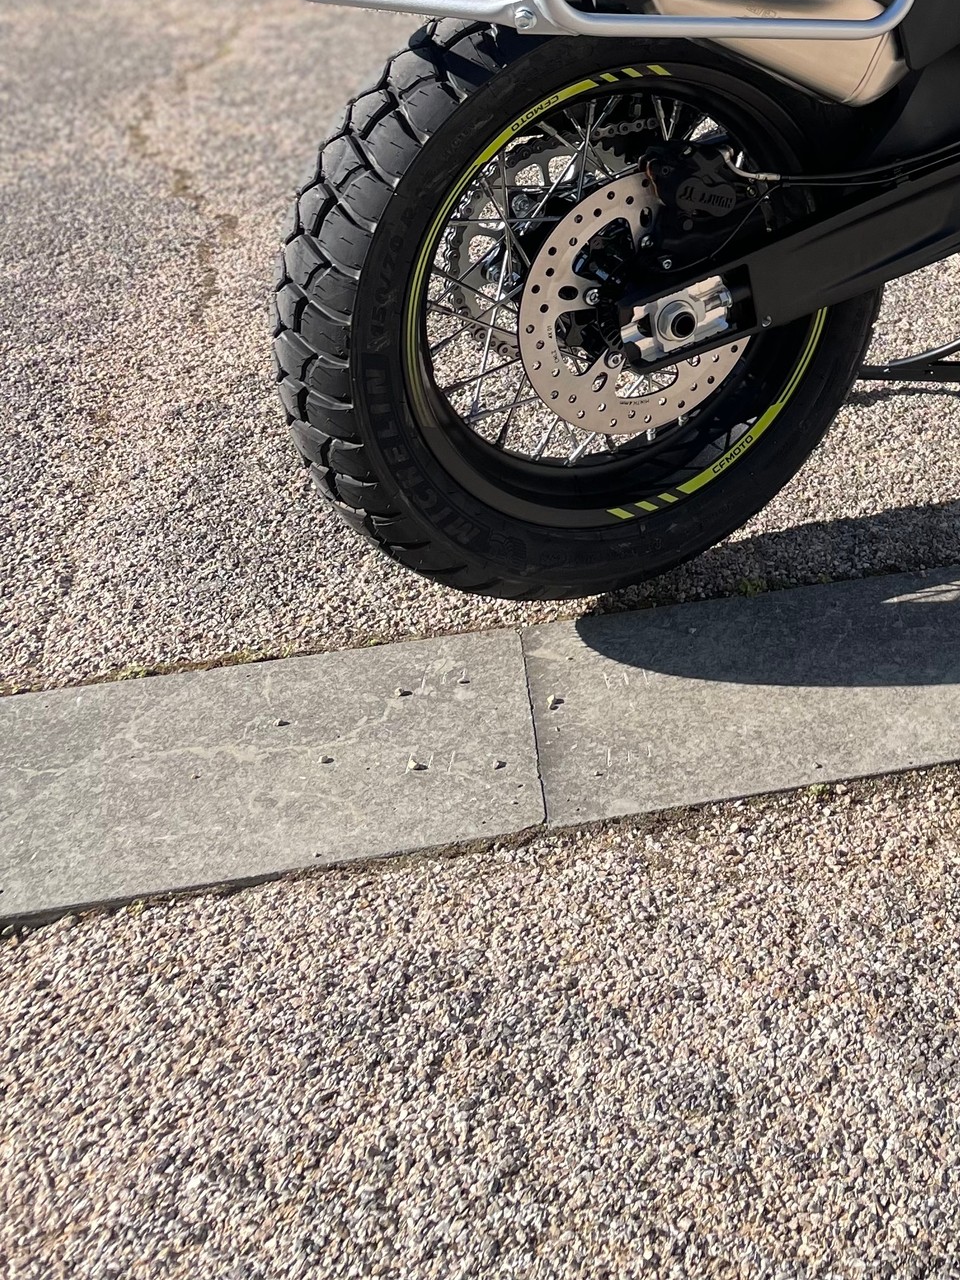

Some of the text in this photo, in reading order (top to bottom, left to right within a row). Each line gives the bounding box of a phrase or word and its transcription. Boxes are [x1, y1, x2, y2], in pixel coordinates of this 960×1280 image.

[510, 94, 560, 132] CFMOTO
[364, 366, 484, 547] MICHELIN
[712, 435, 754, 474] CFMOTO
